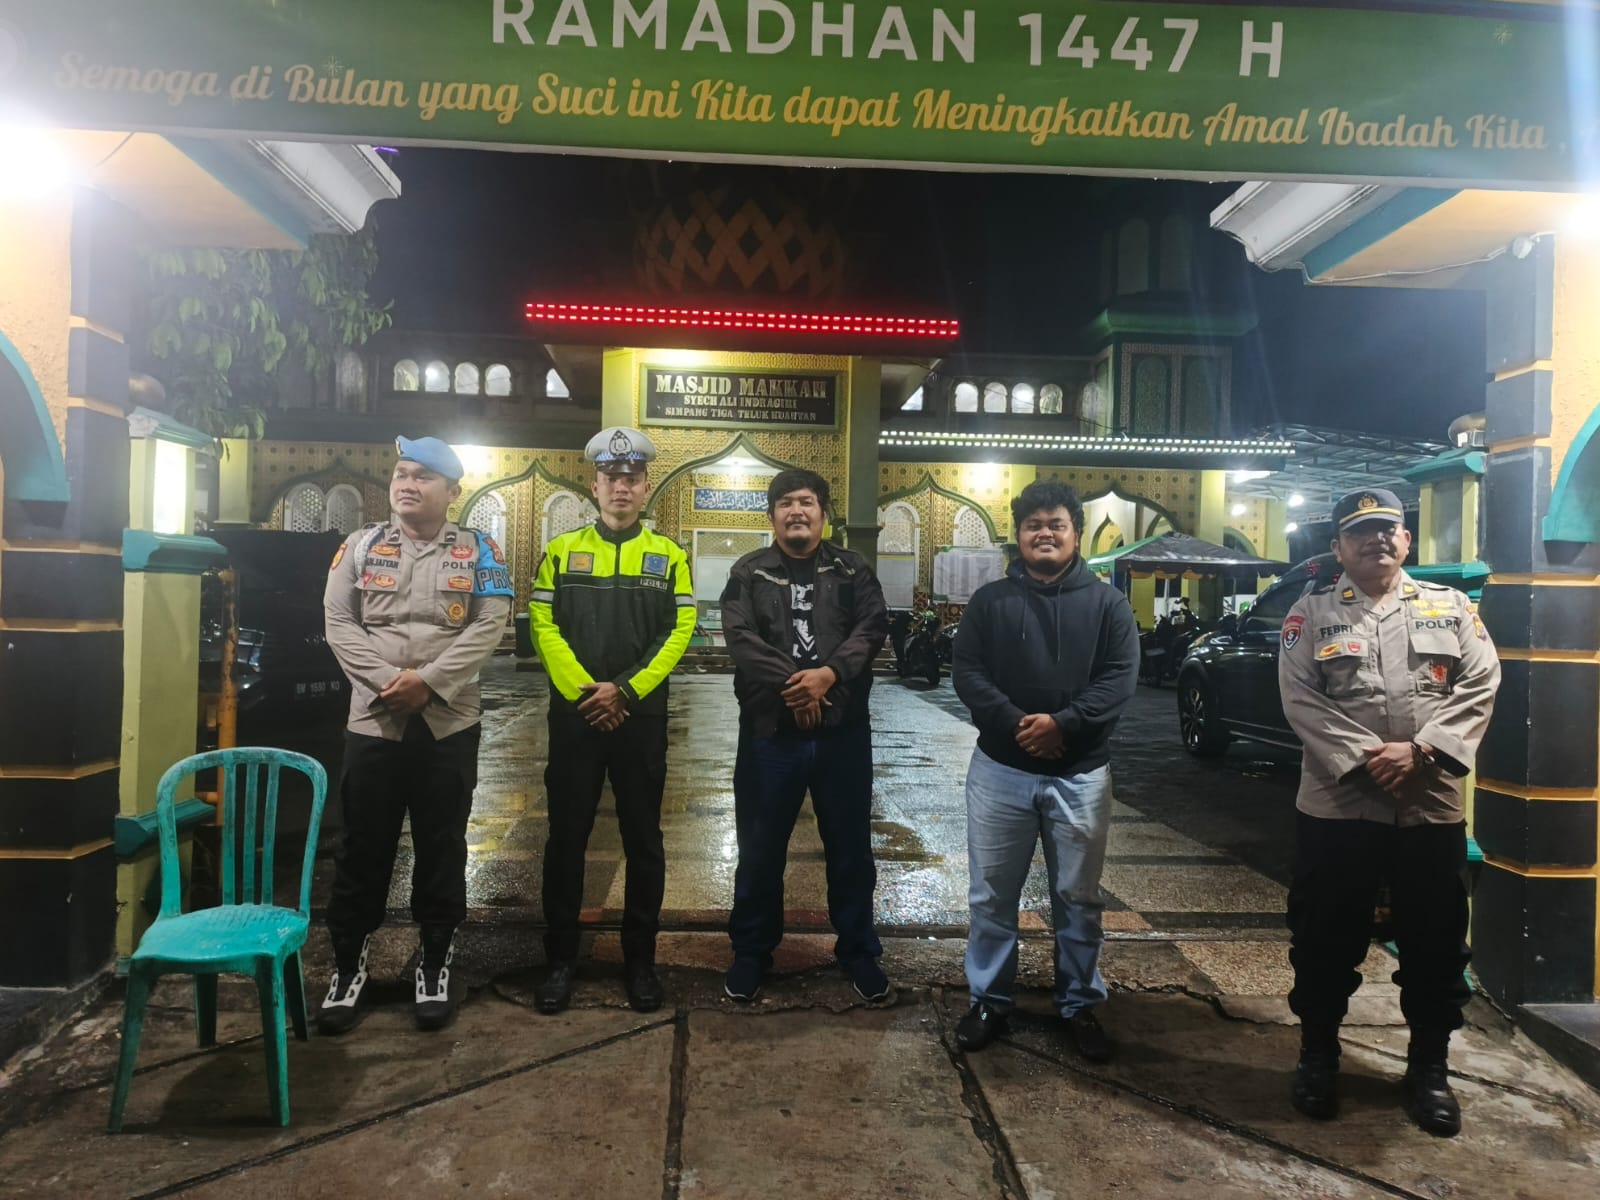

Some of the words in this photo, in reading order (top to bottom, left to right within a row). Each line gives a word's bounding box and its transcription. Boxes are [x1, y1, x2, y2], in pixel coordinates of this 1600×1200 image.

[492, 0, 976, 63] RAMADHAN
[1018, 12, 1199, 73] 1447
[1239, 20, 1284, 78] H
[53, 50, 221, 107] Semoga
[229, 64, 273, 101] di
[284, 63, 409, 109] Bulan
[417, 80, 521, 125] yang
[533, 72, 619, 117] Suci
[626, 77, 682, 119] ini
[689, 79, 776, 123] Kita
[783, 84, 902, 137] dapat
[912, 87, 1194, 146] Meningkatkan
[1203, 102, 1310, 148] Amal
[1317, 106, 1458, 149] Ibadah
[655, 374, 732, 396] MASJID
[738, 377, 828, 399] MAKKAH
[683, 394, 718, 407] SYECH
[719, 395, 737, 408] ALI
[739, 395, 798, 409] INDRAGIRI
[665, 407, 708, 418] SIMPANG
[711, 408, 734, 419] TIGA
[738, 409, 769, 420] TELUK
[771, 411, 817, 423] KUANTAN
[1319, 624, 1353, 639] FEBRI
